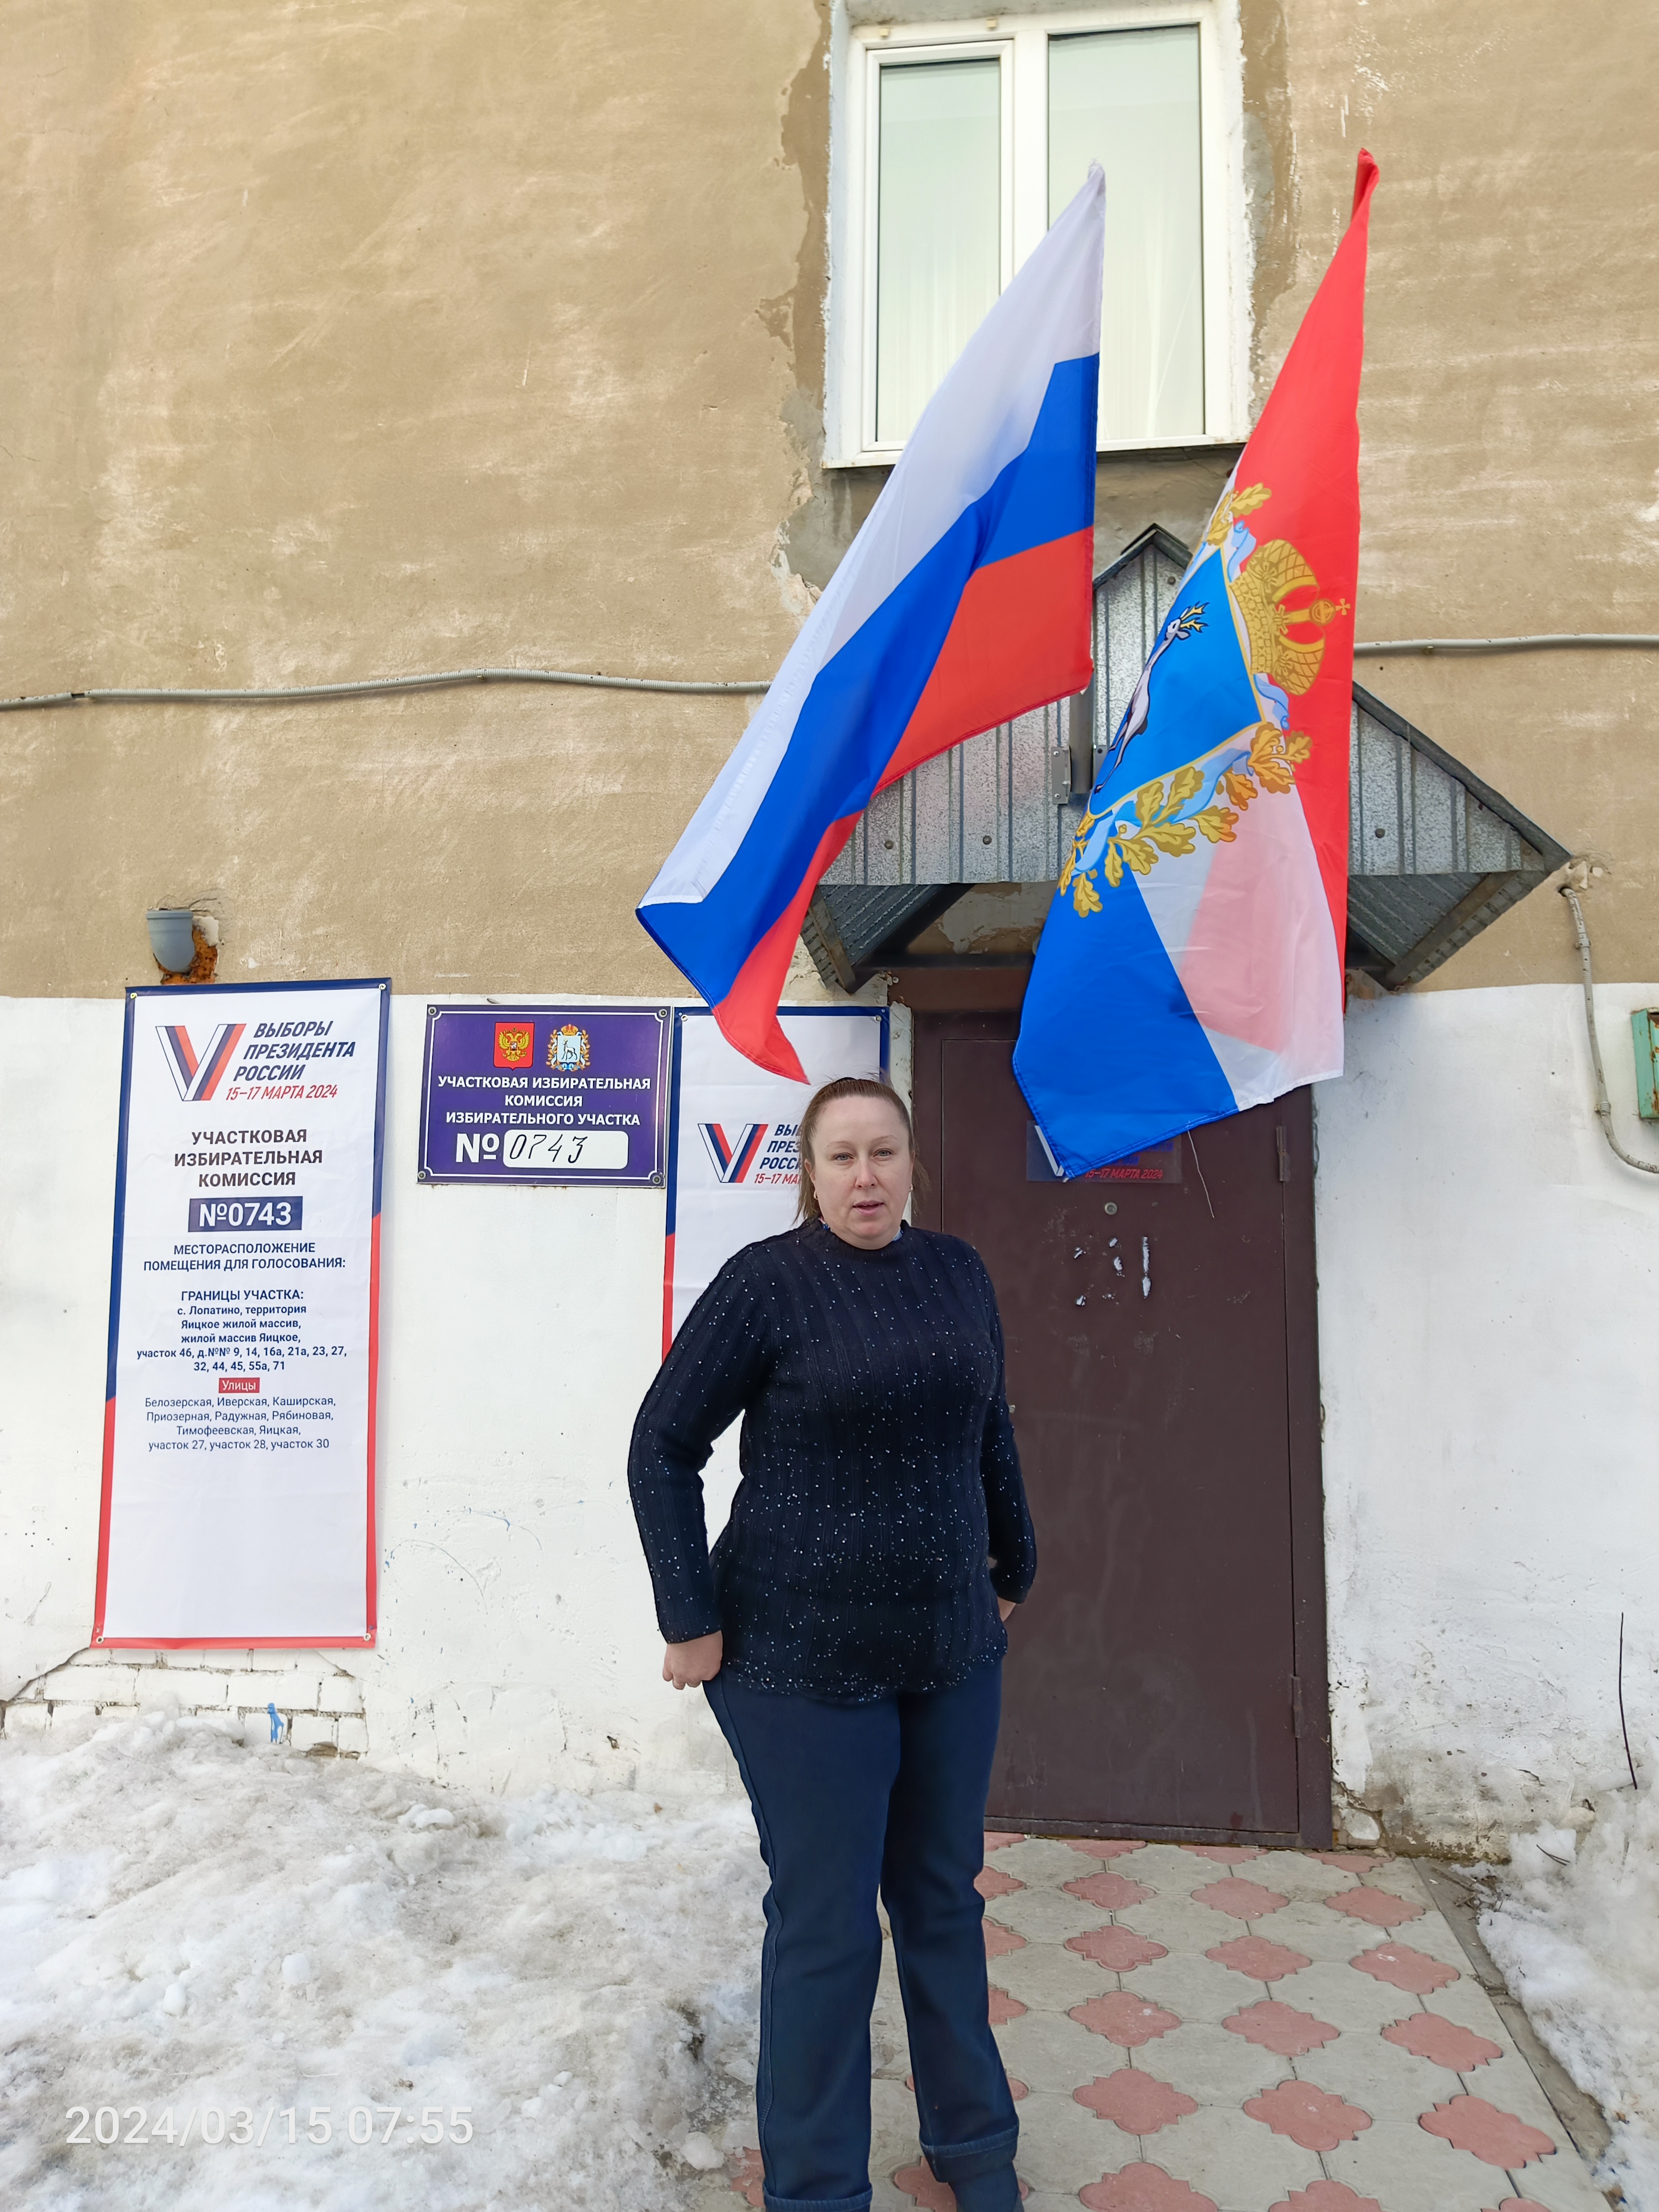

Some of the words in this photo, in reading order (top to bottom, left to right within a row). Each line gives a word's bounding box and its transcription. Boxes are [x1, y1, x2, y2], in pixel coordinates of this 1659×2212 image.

[253, 1021, 334, 1038] ВЫБОРЫ
[243, 1041, 356, 1061] ПРЕЗИДЕНТА
[233, 1064, 306, 1082] РОССИИ
[438, 1076, 528, 1088] УЧАСТКОВАЯ
[532, 1077, 651, 1089] ИЗБИРАТЕЛЬНАЯ
[261, 1085, 305, 1099] МАРТА
[305, 1084, 338, 1098] 2024
[505, 1094, 583, 1107] КОМИССИЯ
[446, 1112, 574, 1125] ИЗБИРАТЕЛЬНОГО
[577, 1114, 640, 1125] УЧАСТКА
[192, 1129, 307, 1145] УЧАСТКОВАЯ
[509, 1134, 588, 1164] 0743
[174, 1150, 323, 1166] ИЗБИРАТЕЛЬНАЯ
[199, 1172, 296, 1187] КОМИССИЯ
[174, 1242, 315, 1255] МЕСТОРАСПОЛОЖЕНИЕ
[144, 1259, 221, 1272] ПОМЕЩЕНИЯ
[223, 1259, 249, 1272] ДЛЯ
[252, 1257, 346, 1269] ГОЛОСОВАНИЯ:
[181, 1290, 240, 1302] ГРАНИЦЫ
[243, 1289, 303, 1300] УЧАСТКА:
[189, 1306, 242, 1316] Лопатино,
[245, 1306, 306, 1316] территория
[181, 1320, 220, 1331] Яицкое
[223, 1319, 256, 1328] жилой
[259, 1320, 301, 1329] массив,
[181, 1333, 216, 1343] жилой
[259, 1333, 301, 1344] Яицкое,
[137, 1350, 177, 1360] участок
[179, 1348, 194, 1358] 46,
[233, 1347, 242, 1358] 9,
[246, 1347, 260, 1358] 14,
[264, 1346, 285, 1358] 16а,
[288, 1346, 309, 1358] 21а,
[313, 1346, 328, 1357] 23,
[331, 1346, 347, 1357] 27,
[193, 1361, 209, 1373] 32,
[212, 1361, 228, 1372] 44,
[230, 1361, 246, 1372] 45,
[249, 1361, 270, 1372] 55а,
[273, 1360, 284, 1370] 71
[222, 1380, 256, 1392] Улицы
[145, 1397, 214, 1409] Белозерская,
[217, 1397, 270, 1408] Иверская,
[273, 1396, 336, 1408] Каширская,
[146, 1412, 212, 1423] Приозерная,
[215, 1411, 269, 1423] Радужная,
[272, 1410, 334, 1421] Рябиновая,
[177, 1425, 256, 1437] Тимофеевская,
[259, 1425, 301, 1436] Яицкая,
[148, 1442, 189, 1452] участок
[192, 1440, 207, 1451] 27,
[209, 1441, 251, 1452] участок
[253, 1439, 268, 1450] 28,
[271, 1441, 313, 1451] участок
[316, 1438, 329, 1448] 30
